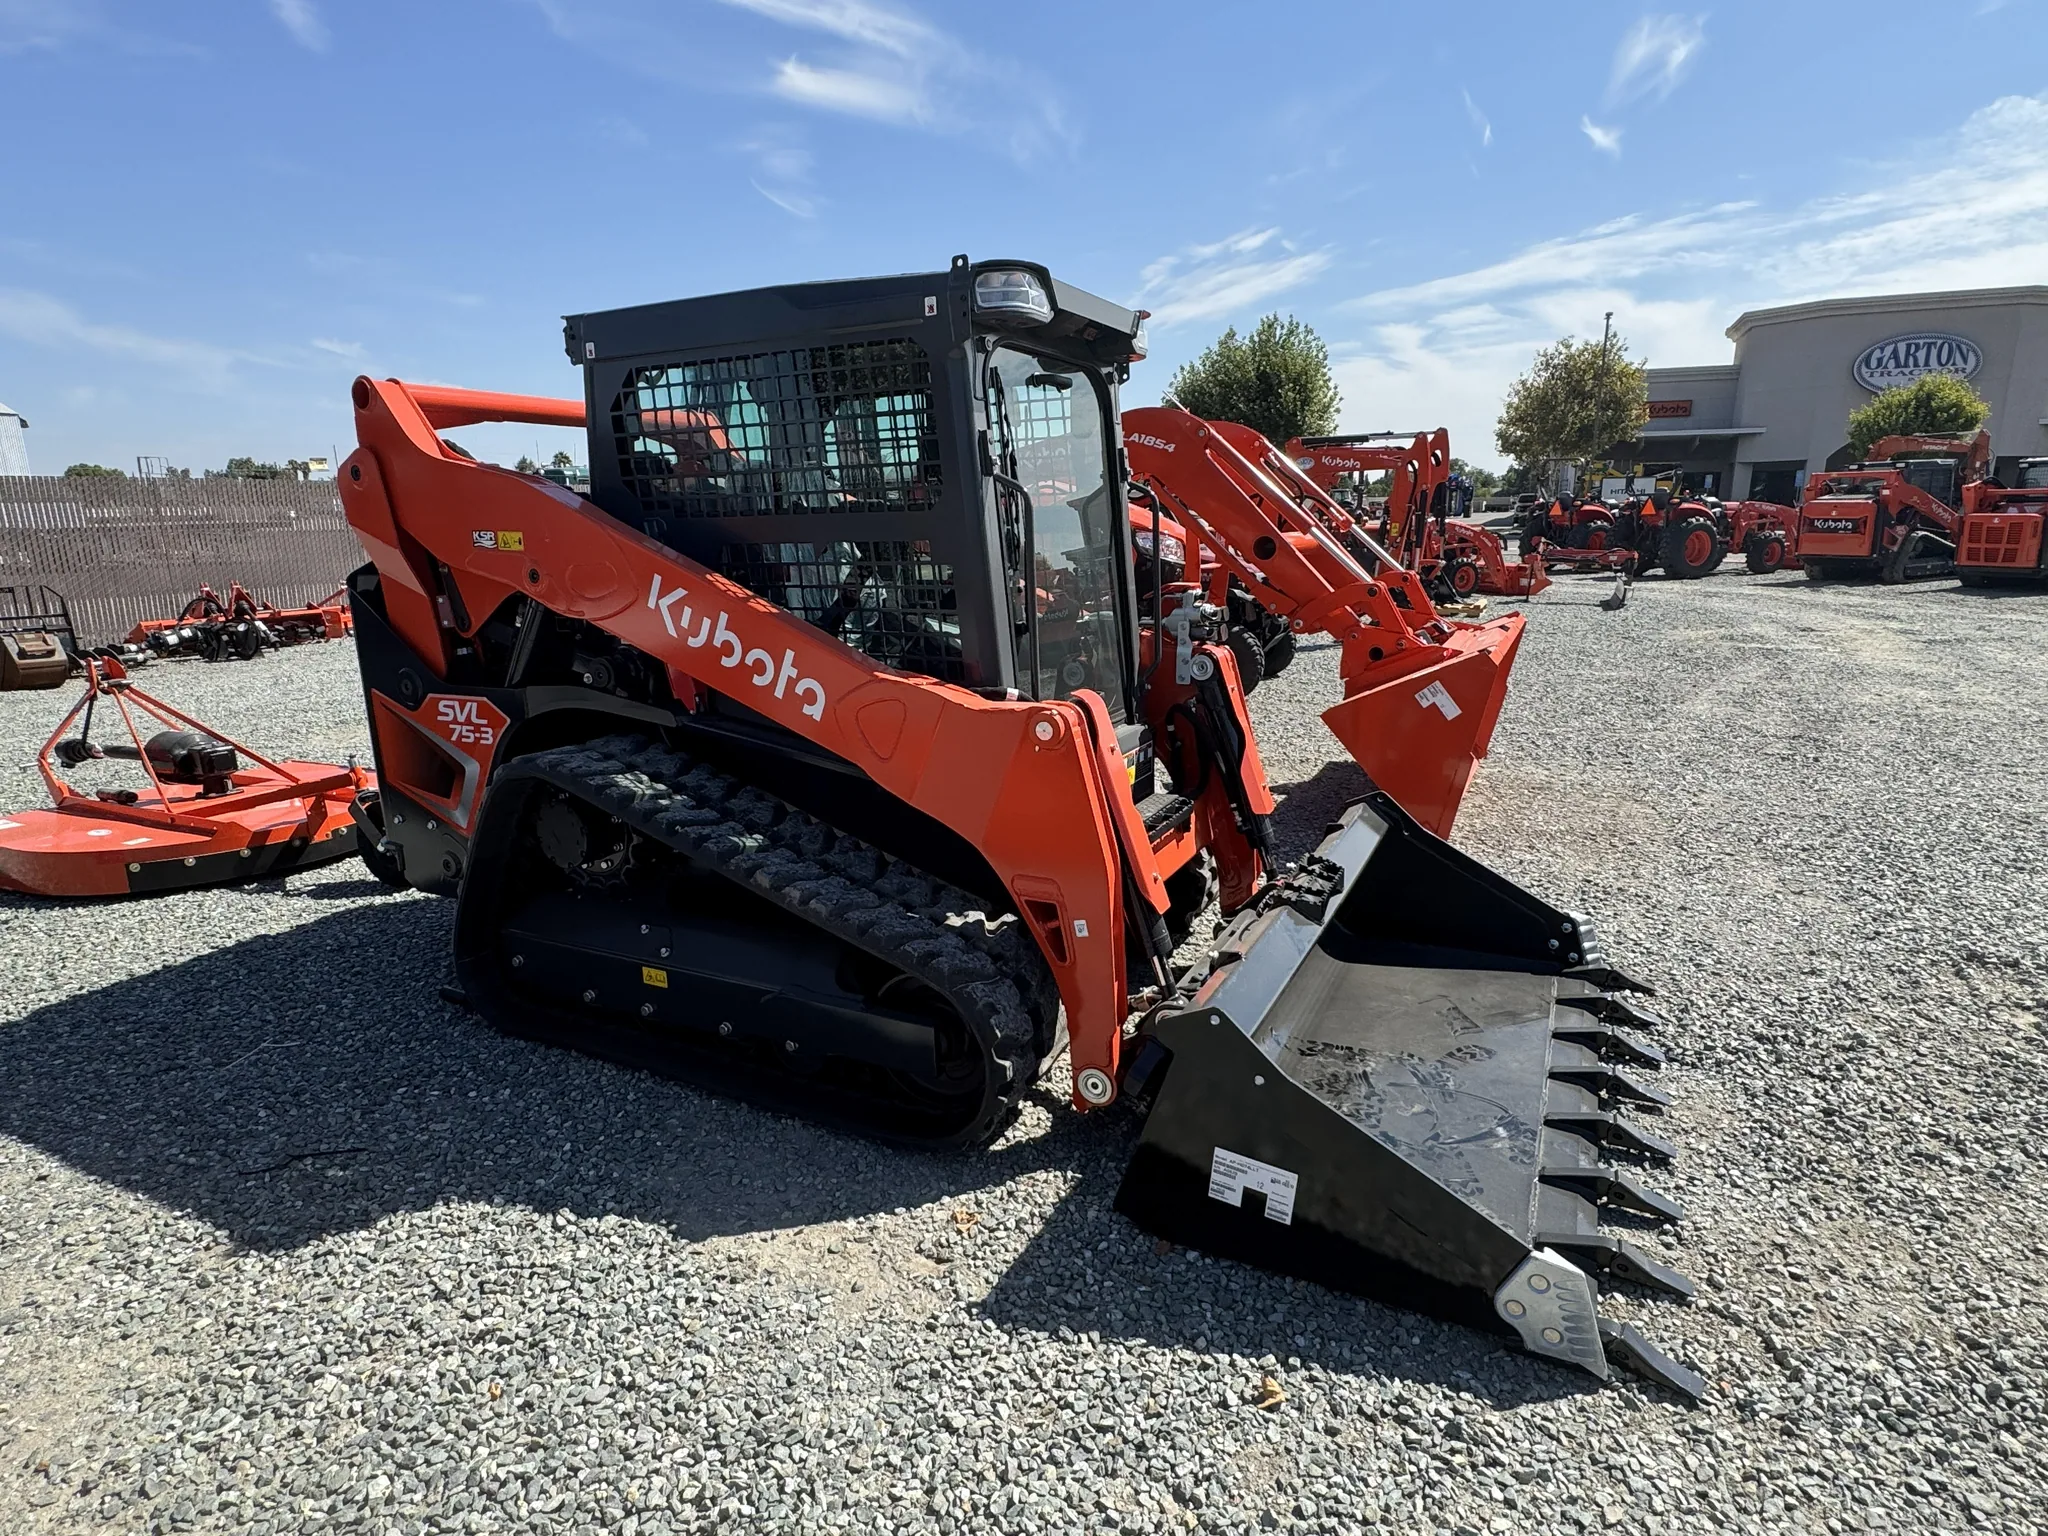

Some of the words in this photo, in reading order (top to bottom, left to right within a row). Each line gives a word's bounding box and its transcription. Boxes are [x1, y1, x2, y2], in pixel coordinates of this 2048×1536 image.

[1864, 341, 1971, 370] GARTON
[1122, 431, 1176, 453] LA1854
[1321, 455, 1361, 468] Kubota
[1814, 519, 1853, 529] Kubota
[472, 531, 495, 541] KSR
[647, 573, 826, 722] Kubota
[437, 700, 488, 724] SVL
[448, 724, 493, 744] 75-3
